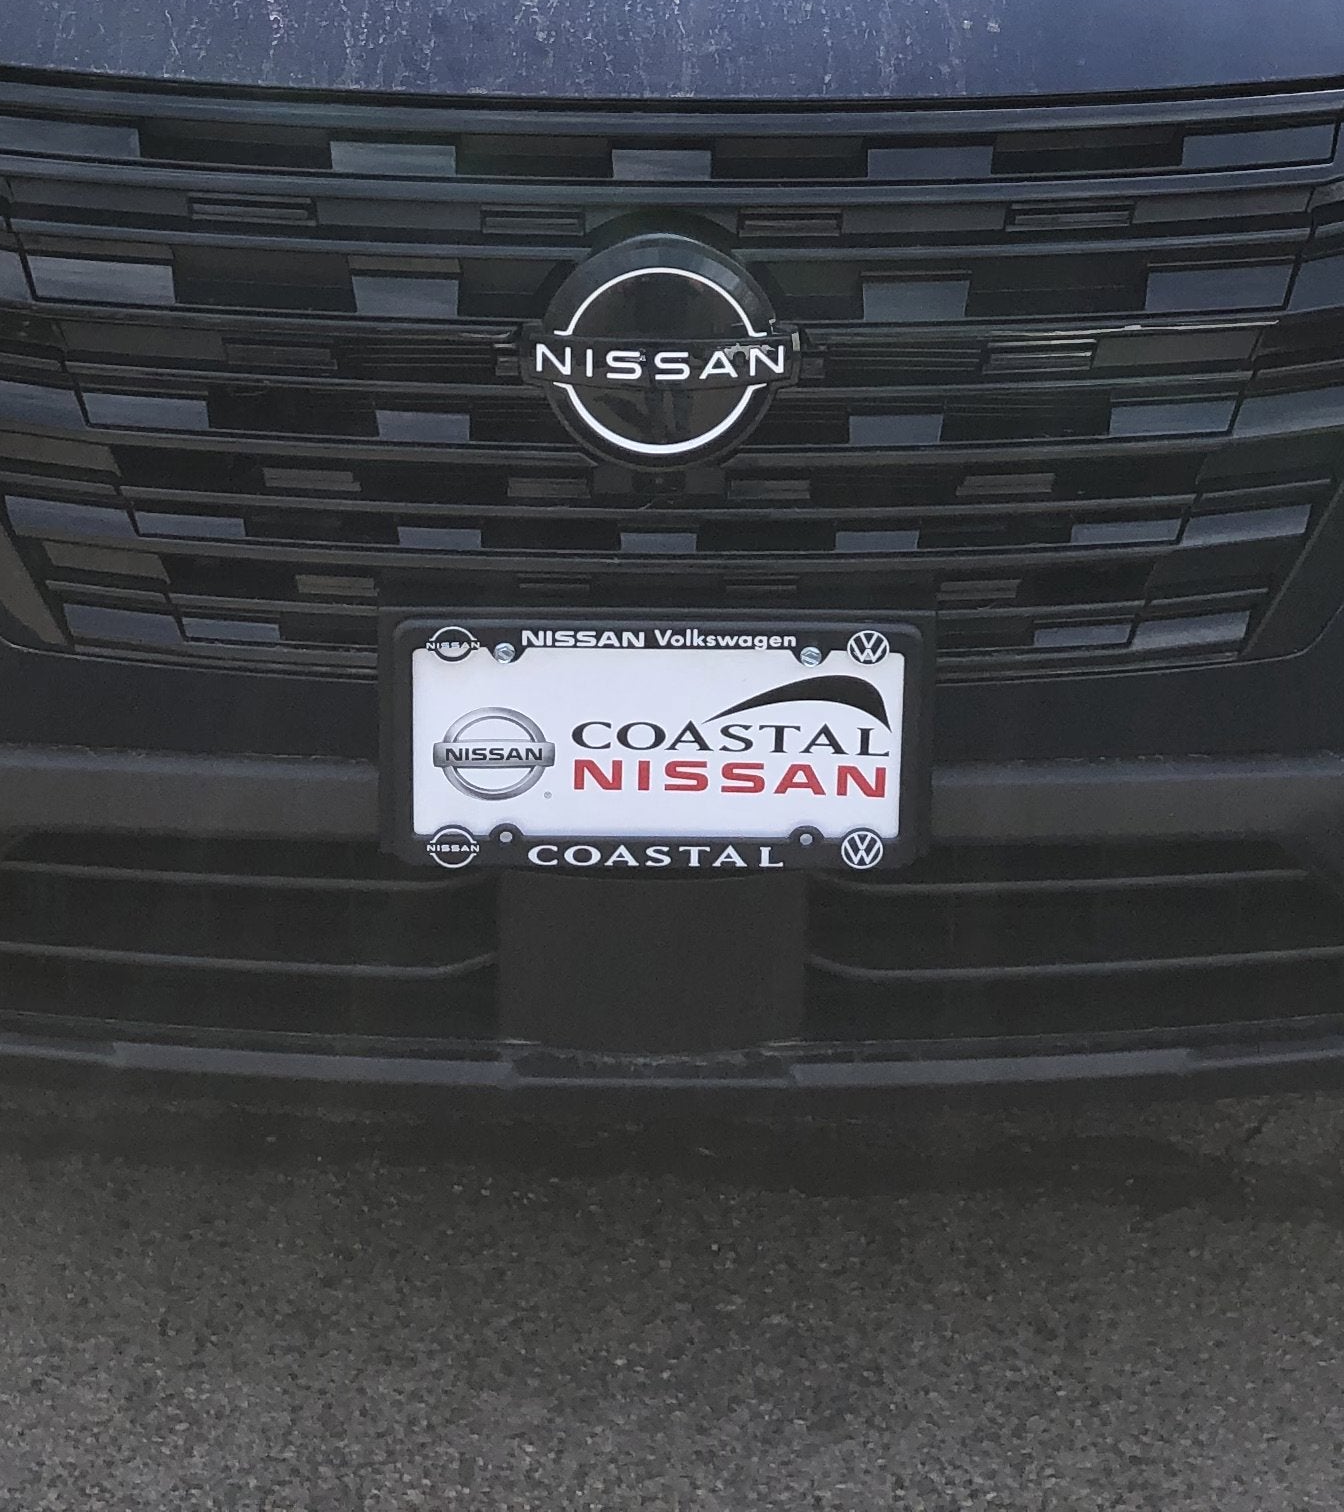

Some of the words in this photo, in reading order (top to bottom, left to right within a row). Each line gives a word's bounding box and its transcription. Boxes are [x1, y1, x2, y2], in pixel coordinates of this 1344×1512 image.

[536, 343, 784, 380] NISSAN
[426, 641, 480, 650] NISSAN
[522, 629, 644, 648] NISSAN
[654, 629, 796, 650] Volkswagen
[571, 720, 890, 757] COASTAL
[445, 747, 543, 762] NISSAN
[573, 759, 887, 798] NISSAN
[426, 843, 480, 853] NISSAN
[527, 844, 784, 867] COASTAL
